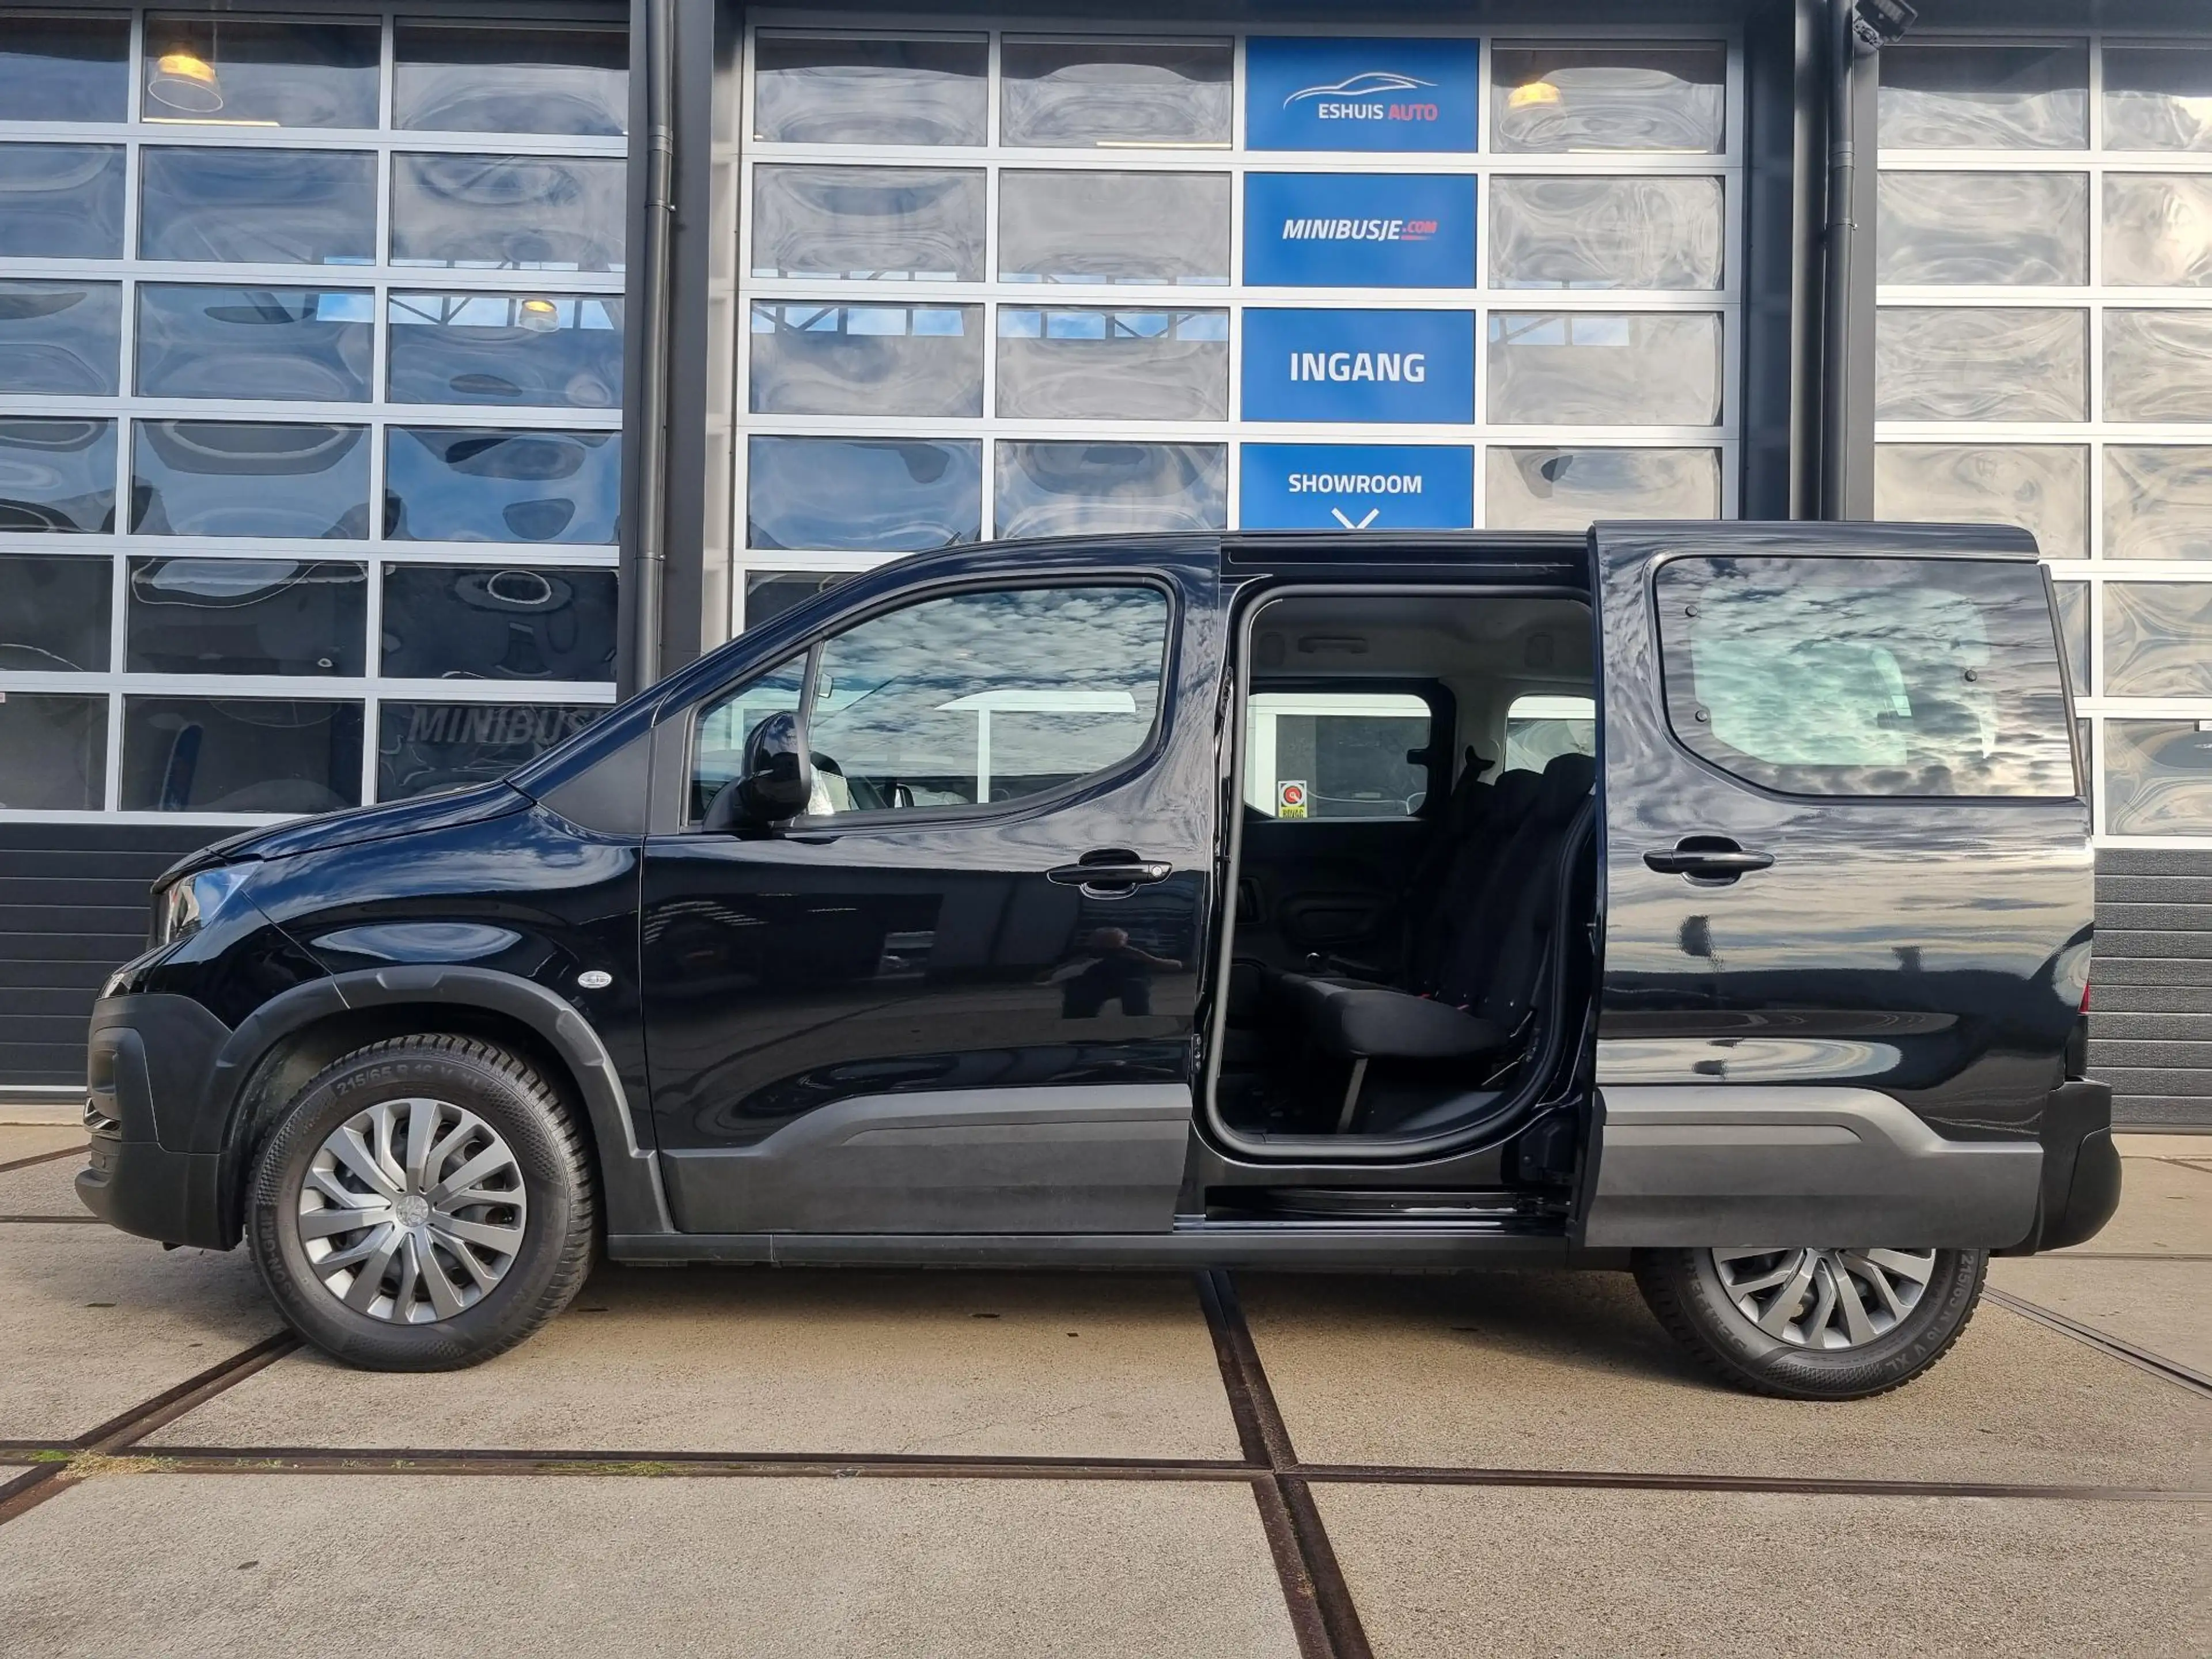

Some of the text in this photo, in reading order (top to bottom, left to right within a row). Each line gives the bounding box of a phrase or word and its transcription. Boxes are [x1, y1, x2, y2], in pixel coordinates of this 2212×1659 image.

[1319, 104, 1438, 121] ESHUIS AUTO
[1290, 353, 1425, 382] INGANG
[1289, 474, 1422, 493] SHOWROOM
